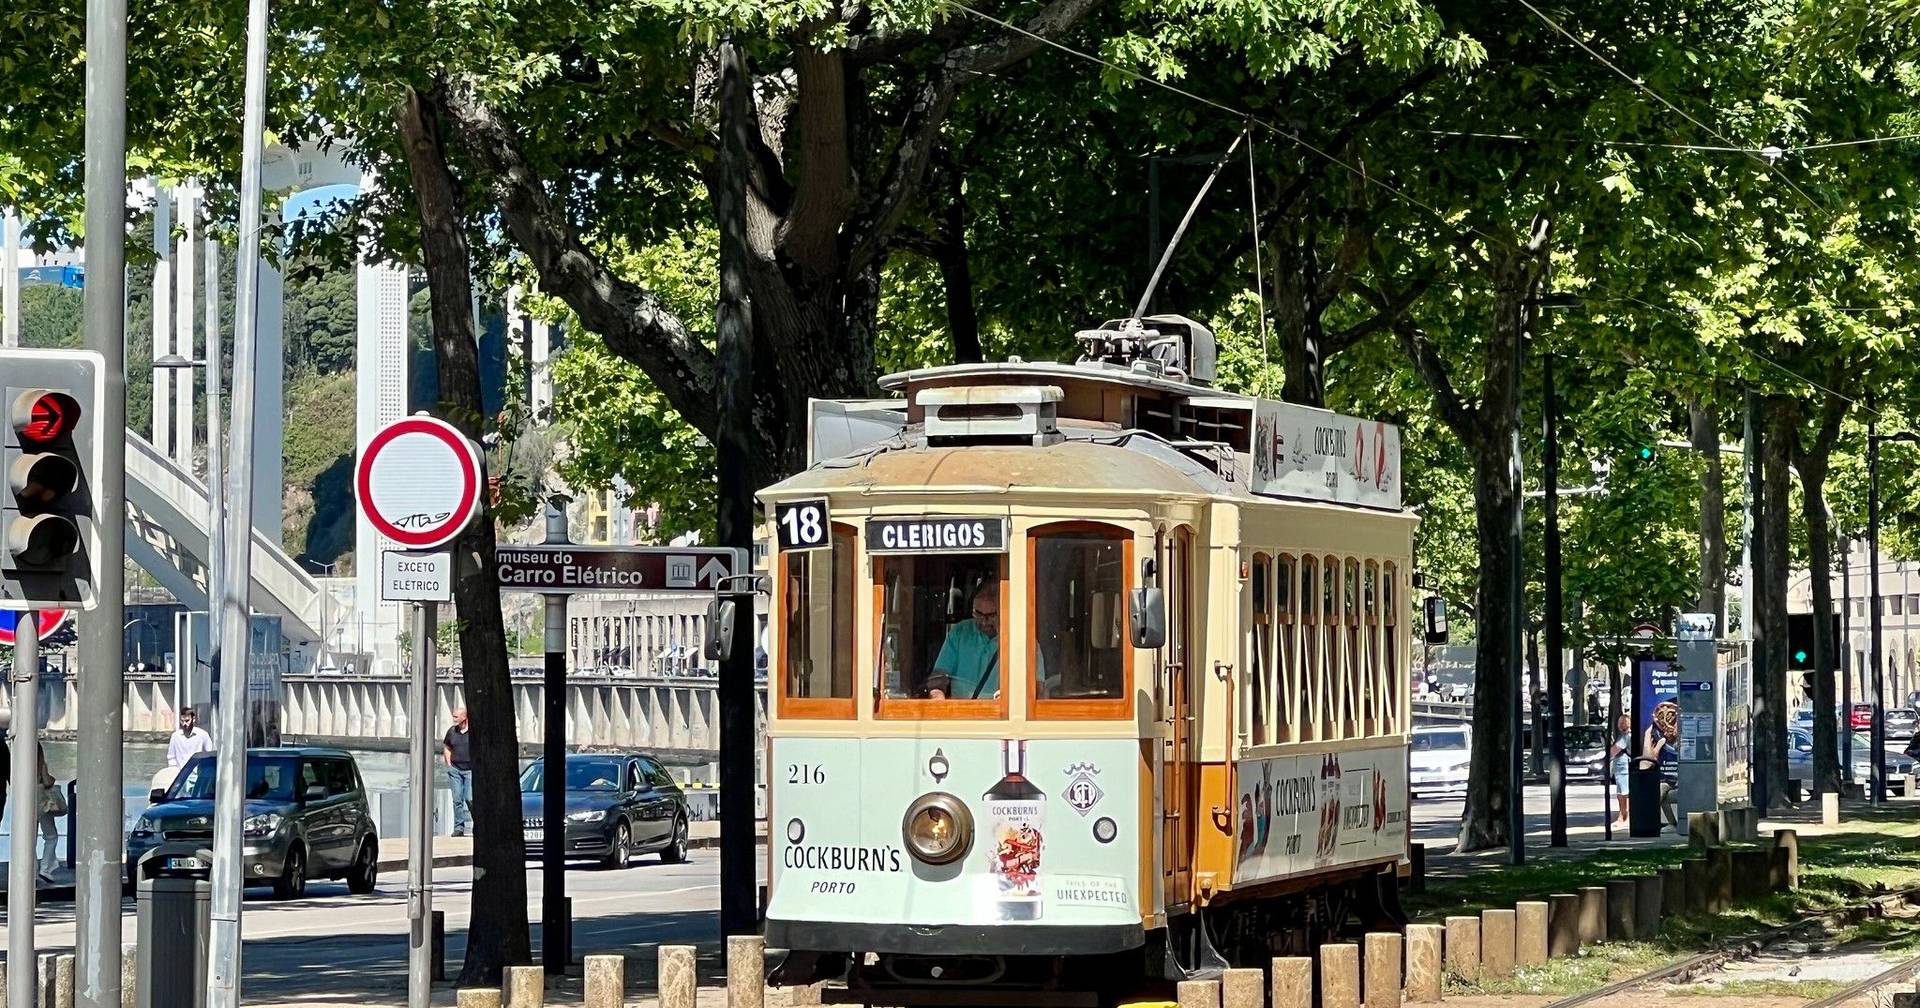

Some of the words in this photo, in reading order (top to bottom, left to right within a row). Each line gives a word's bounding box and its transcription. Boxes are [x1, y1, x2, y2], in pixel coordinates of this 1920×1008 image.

[781, 506, 823, 545] 18
[882, 522, 986, 548] CLERIGOS
[398, 562, 435, 572] EXCETO
[498, 552, 548, 564] museu
[553, 551, 573, 564] do
[497, 564, 556, 583] Carro
[562, 565, 643, 585] Elétrico
[788, 763, 825, 784] 216
[1275, 774, 1316, 816] COCKBURN'S
[784, 845, 901, 873] COCKBURN'S
[811, 881, 856, 894] PORTO
[1056, 889, 1128, 904] UNEXPECTED
